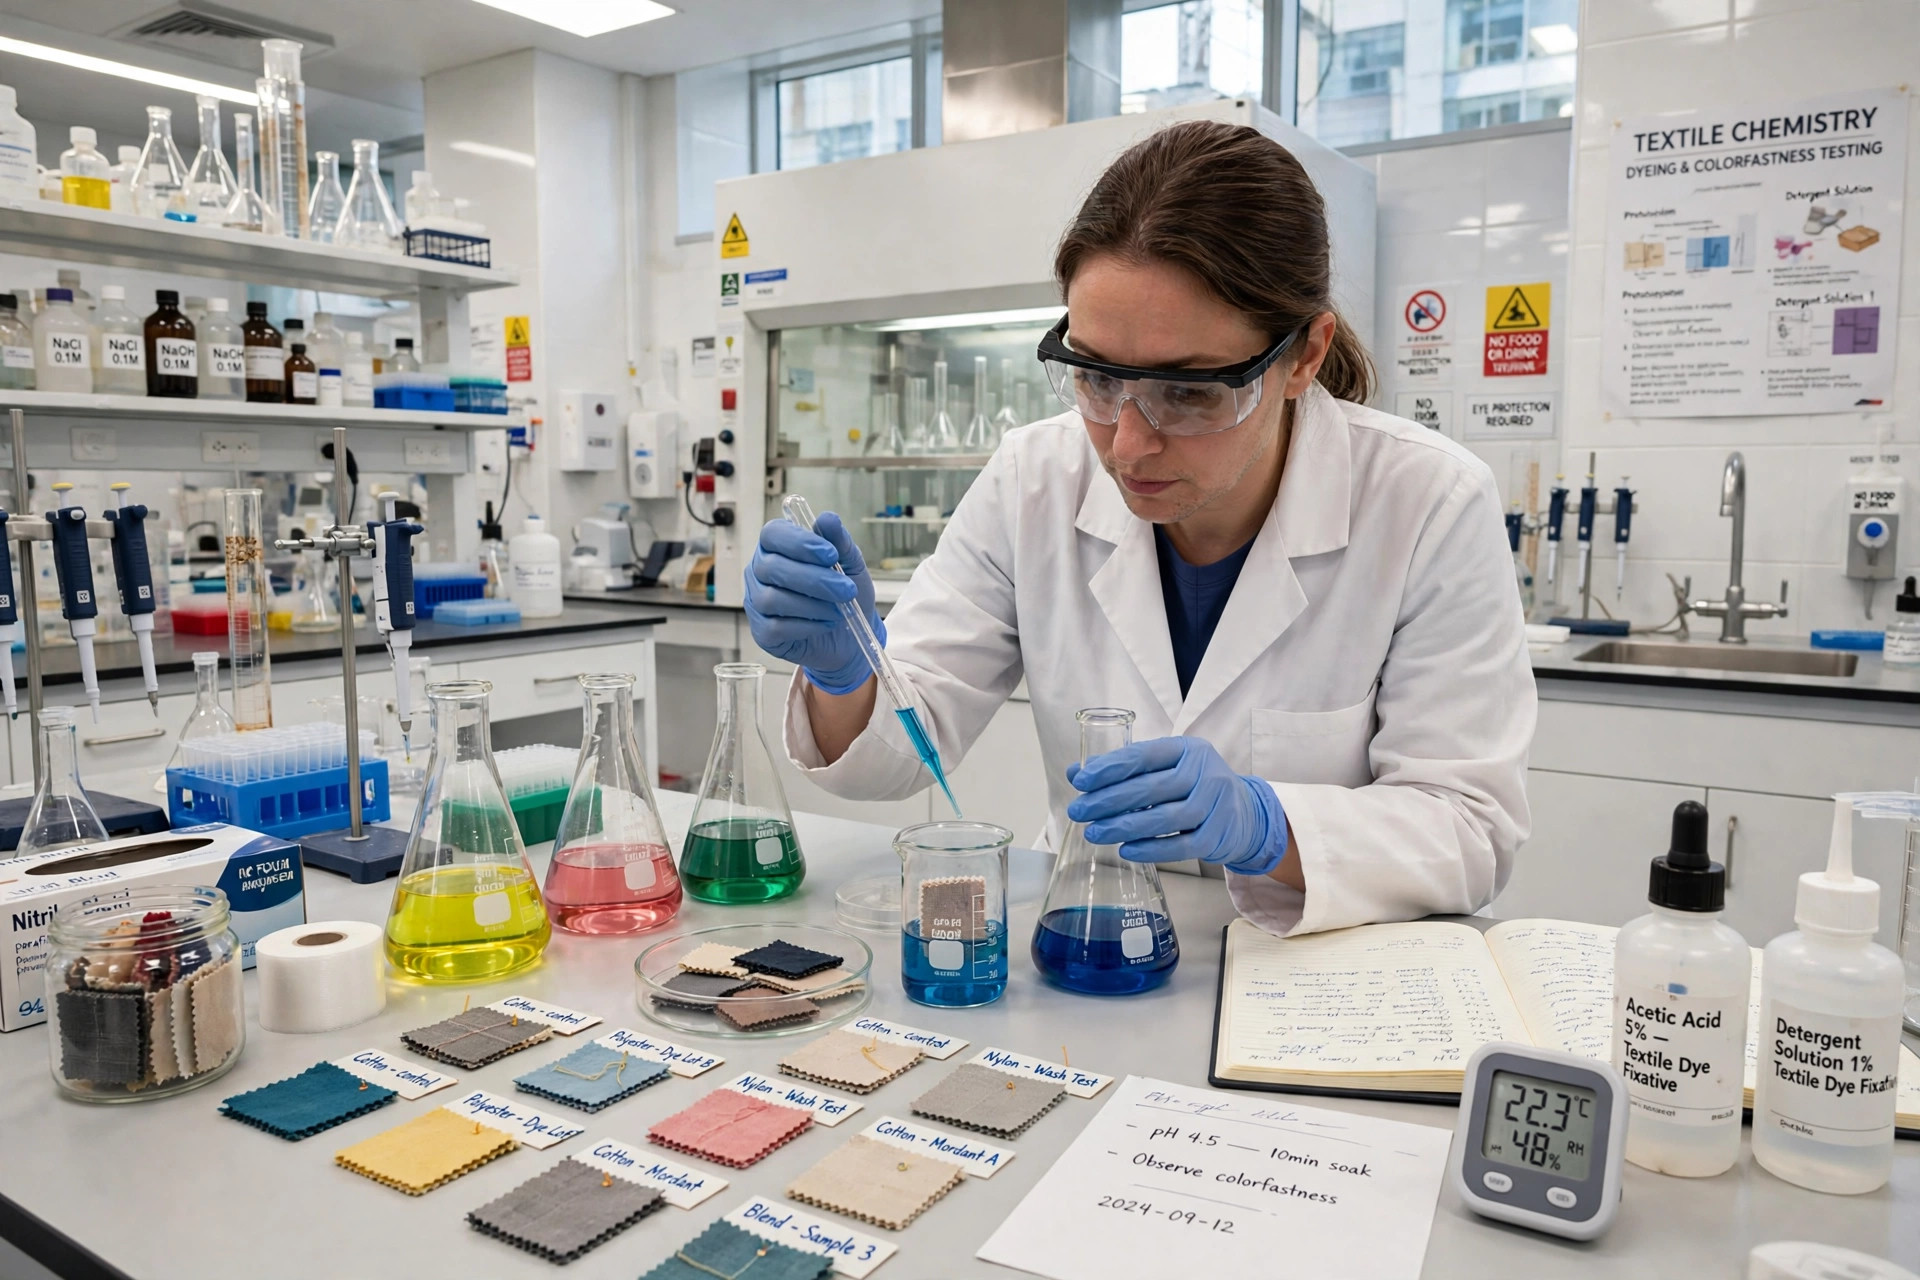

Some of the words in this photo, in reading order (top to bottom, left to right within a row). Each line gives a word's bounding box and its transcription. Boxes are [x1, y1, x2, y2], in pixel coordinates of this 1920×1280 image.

[1633, 124, 1724, 153] TEXTILE
[1731, 106, 1879, 143] CHEMISTRY
[1626, 161, 1677, 179] DYEING
[1680, 161, 1690, 174] &
[1694, 148, 1815, 174] COLORFASTNESS
[1820, 141, 1883, 160] TESTING
[53, 338, 82, 350] NaCl
[109, 339, 138, 351] NaCl
[1489, 335, 1507, 348] NO
[1508, 333, 1543, 347] FOOD
[54, 351, 82, 363] 0.1M
[112, 353, 139, 364] 0.1M
[163, 358, 190, 369] 0.1M
[1492, 401, 1551, 413] PROTECTION
[503, 997, 536, 1013] Cotton
[1626, 997, 1676, 1025] Acetic
[1681, 1010, 1721, 1029] Acid
[856, 1019, 891, 1035] Cotton
[1625, 1018, 1647, 1041] 5%
[1776, 1017, 1862, 1051] Detergent
[353, 1052, 389, 1071] Cotton
[608, 1030, 655, 1051] Polyester
[660, 1046, 682, 1061] Dye
[682, 1053, 703, 1064] Lot
[700, 1059, 714, 1068] B
[1623, 1040, 1673, 1071] Textile
[1678, 1057, 1711, 1079] Dye
[1774, 1039, 1844, 1071] Solution
[1850, 1055, 1874, 1072] 1%
[983, 1051, 1019, 1067] Nylon
[1034, 1063, 1067, 1080] Wash
[1071, 1073, 1099, 1087] Test
[1623, 1061, 1678, 1092] Fixative
[1773, 1060, 1820, 1089] Textile
[1825, 1075, 1856, 1097] Dye
[737, 1076, 773, 1093] Nylon
[785, 1089, 818, 1107] Wash
[819, 1099, 847, 1115] Test
[463, 1093, 516, 1119] Polyester
[523, 1116, 549, 1134] Dye
[593, 1144, 635, 1167] Cotton
[876, 1121, 916, 1142] Cotton
[929, 1136, 985, 1161] Mordant
[985, 1153, 1000, 1166] A
[1149, 1126, 1180, 1140] pH
[1188, 1131, 1221, 1147] 4.5
[1270, 1147, 1320, 1168] 10min
[1329, 1160, 1373, 1178] soak
[1567, 1140, 1585, 1157] RH
[1132, 1152, 1204, 1178] Observe
[1215, 1171, 1338, 1205] colorfastness
[743, 1203, 793, 1229] Blend
[800, 1225, 856, 1256] Sample
[858, 1245, 877, 1261] 3
